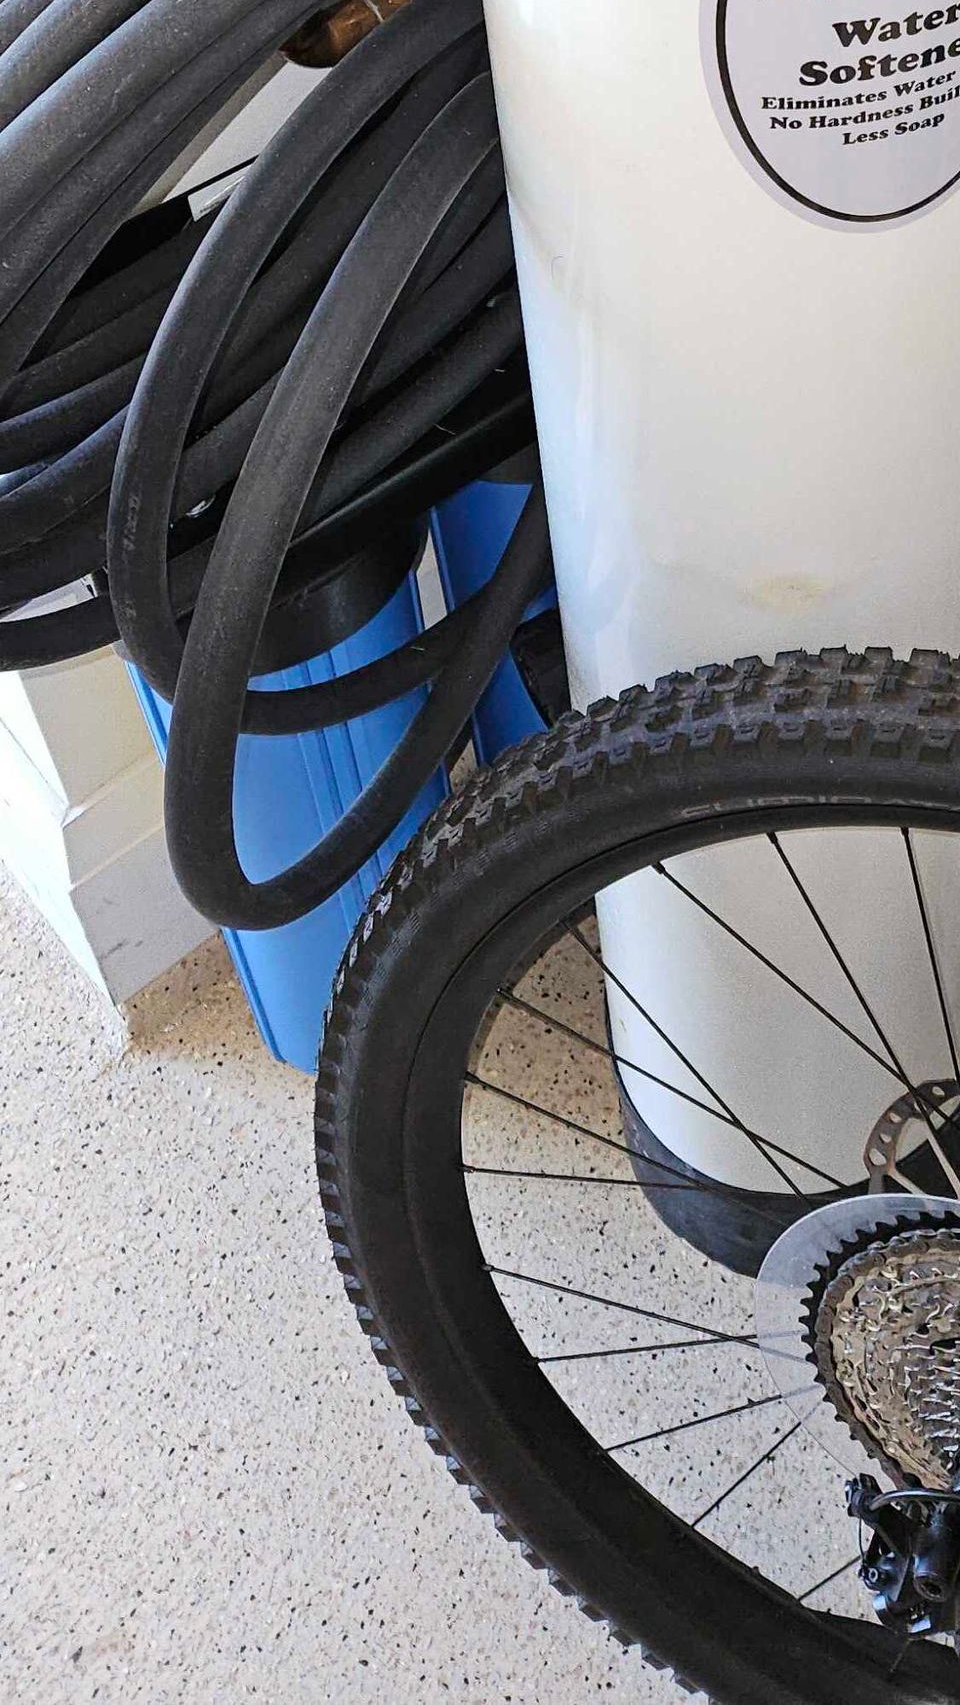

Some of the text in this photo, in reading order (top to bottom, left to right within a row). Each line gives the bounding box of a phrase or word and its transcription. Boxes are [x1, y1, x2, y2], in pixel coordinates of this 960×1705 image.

[762, 89, 887, 110] Eliminates
[893, 70, 956, 96] Water
[770, 116, 802, 130] No
[809, 104, 914, 129] Hardness
[842, 113, 945, 145] Less Soap
